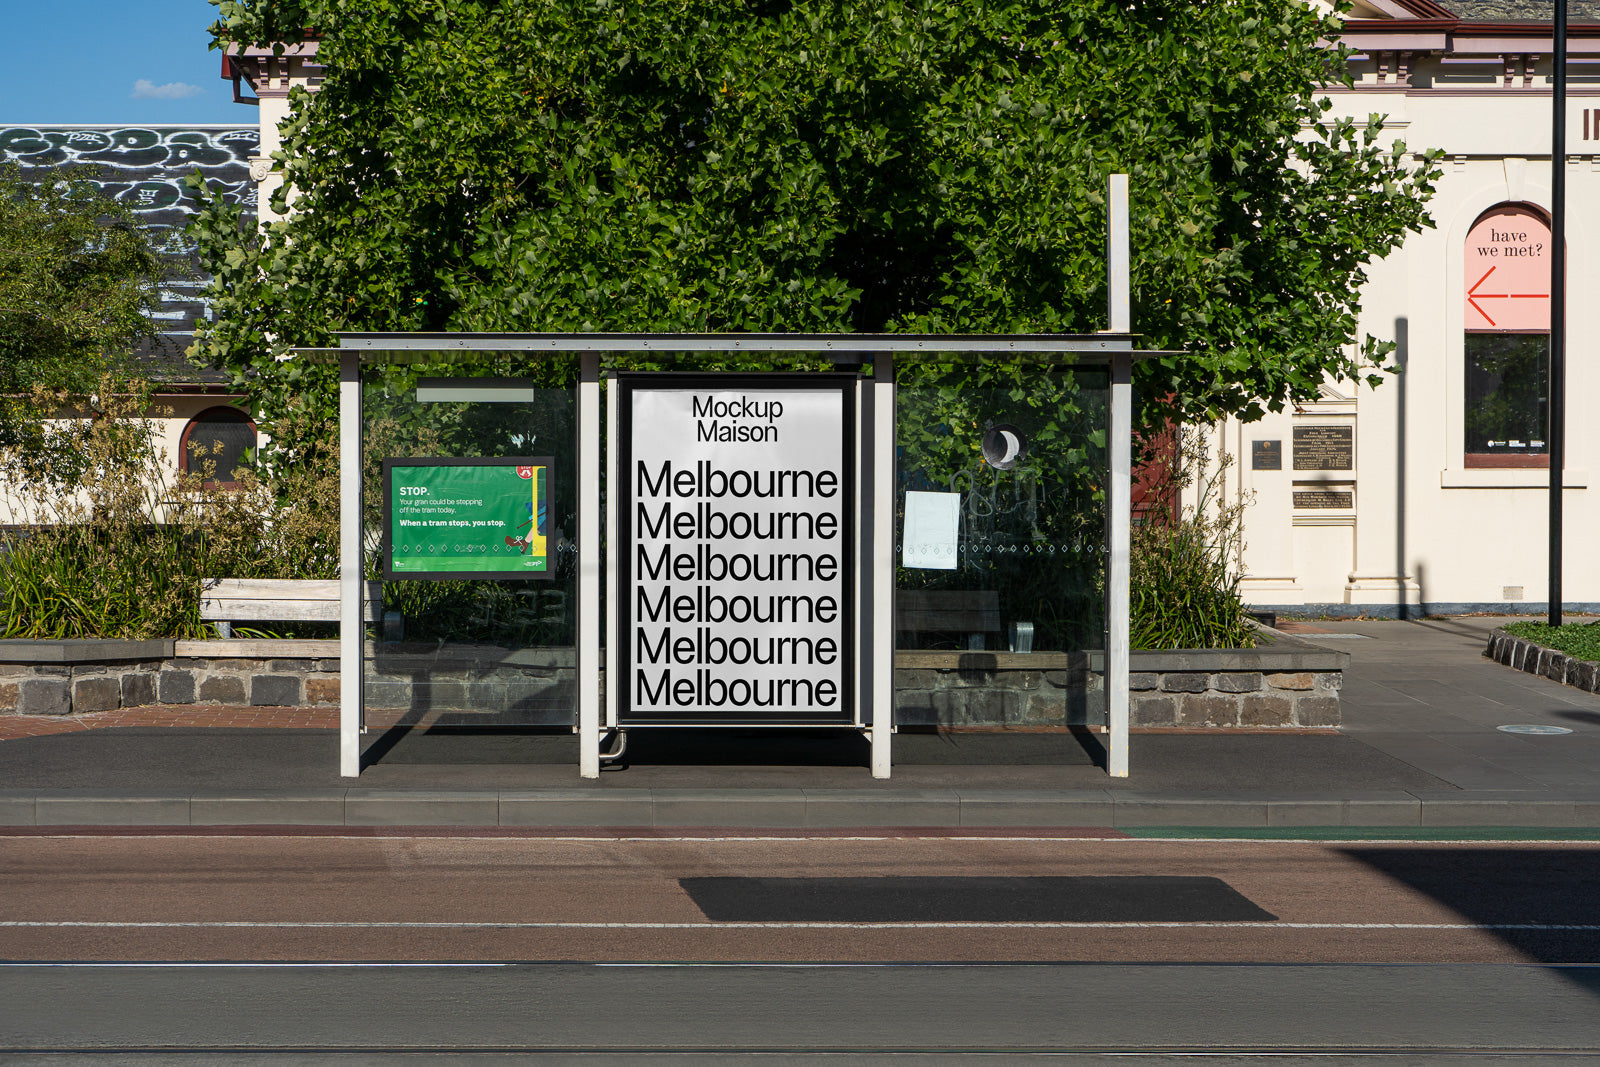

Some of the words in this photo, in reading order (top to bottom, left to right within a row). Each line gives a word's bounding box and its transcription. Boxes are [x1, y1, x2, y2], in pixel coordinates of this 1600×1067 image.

[1491, 229, 1527, 242] have
[1478, 246, 1499, 256] we
[1504, 243, 1543, 257] met?
[693, 396, 783, 423] Mockup
[698, 420, 778, 443] Maison
[400, 486, 430, 496] STOP.
[637, 460, 838, 498] Melbourne
[456, 499, 483, 507] stepping
[448, 520, 472, 528] stops,
[472, 520, 486, 528] you
[487, 520, 506, 528] stop.
[637, 502, 838, 539] Melbourne
[637, 544, 838, 581] Melbourne
[637, 586, 838, 623] Melbourne
[637, 627, 838, 664] Melbourne
[637, 669, 838, 706] Melbourne
